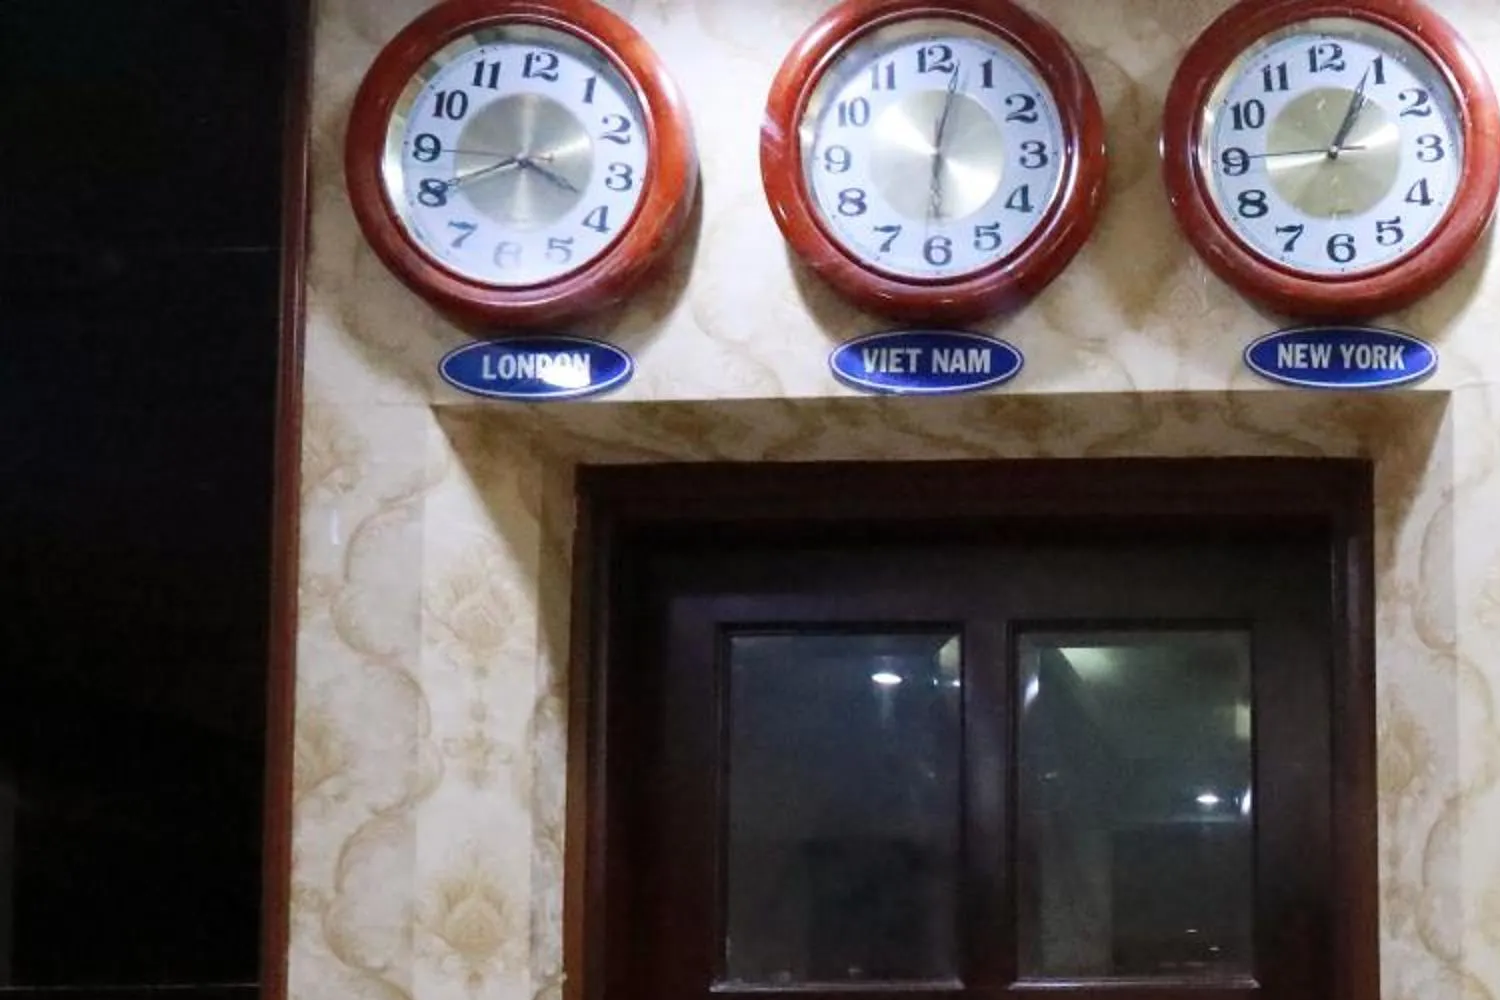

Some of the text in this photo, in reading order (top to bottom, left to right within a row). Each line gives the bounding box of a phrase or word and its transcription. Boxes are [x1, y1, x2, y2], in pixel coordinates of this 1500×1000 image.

[522, 51, 559, 82] 12
[916, 44, 957, 74] 12
[1307, 42, 1346, 73] 12
[1371, 55, 1386, 85] 1
[472, 60, 502, 90] 11
[870, 62, 896, 91] 11
[980, 58, 994, 89] 1
[1262, 62, 1290, 92] 11
[583, 76, 596, 104] 1
[1398, 88, 1432, 118] 2
[432, 90, 468, 121] 10
[837, 97, 870, 128] 10
[1004, 93, 1039, 125] 2
[1229, 99, 1266, 131] 10
[602, 114, 631, 145] 2
[412, 133, 442, 163] 9
[824, 145, 852, 174] 9
[1019, 140, 1049, 170] 3
[1221, 147, 1250, 177] 9
[1416, 133, 1445, 163] 3
[605, 162, 633, 192] 3
[417, 178, 448, 208] 8
[837, 187, 868, 217] 8
[1004, 183, 1035, 213] 4
[1237, 188, 1269, 219] 8
[1404, 178, 1434, 207] 4
[447, 221, 478, 248] 7
[582, 205, 612, 234] 4
[1375, 216, 1405, 246] 5
[546, 236, 575, 264] 5
[873, 224, 902, 253] 7
[923, 235, 954, 266] 6
[973, 222, 1002, 252] 5
[1275, 223, 1305, 253] 7
[1326, 233, 1357, 263] 6
[862, 347, 992, 375] VIET NAM
[1277, 343, 1406, 370] NEW YORK
